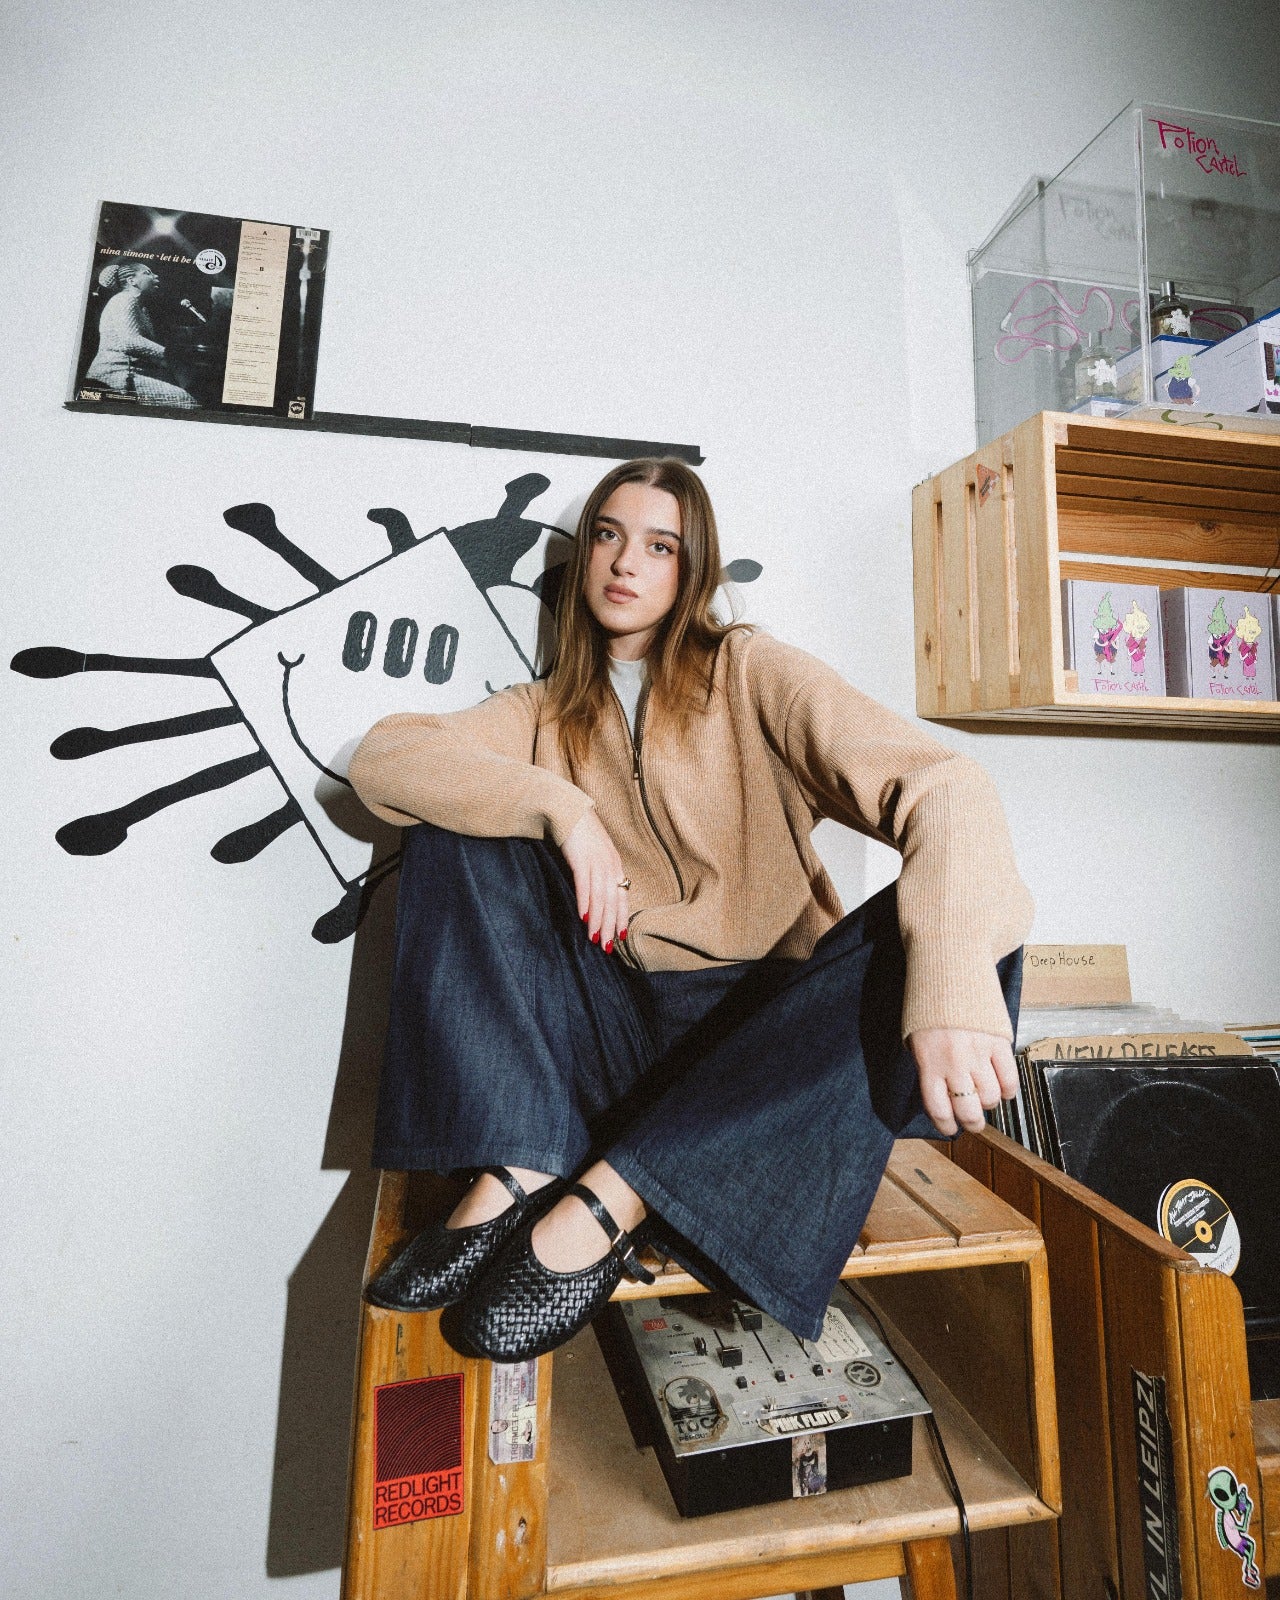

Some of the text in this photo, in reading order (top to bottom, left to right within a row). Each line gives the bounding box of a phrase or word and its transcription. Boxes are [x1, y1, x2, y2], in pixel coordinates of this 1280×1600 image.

[99, 247, 121, 256] nina
[122, 249, 155, 260] simone
[159, 253, 172, 262] let
[172, 254, 180, 263] it
[181, 256, 192, 264] be
[1058, 951, 1096, 966] House
[1054, 1043, 1113, 1060] NEW
[768, 1408, 843, 1436] PINK FLOYD
[375, 1471, 463, 1506] REDLIGHT
[375, 1493, 462, 1526] RECORDS
[1144, 1504, 1165, 1557] IN
